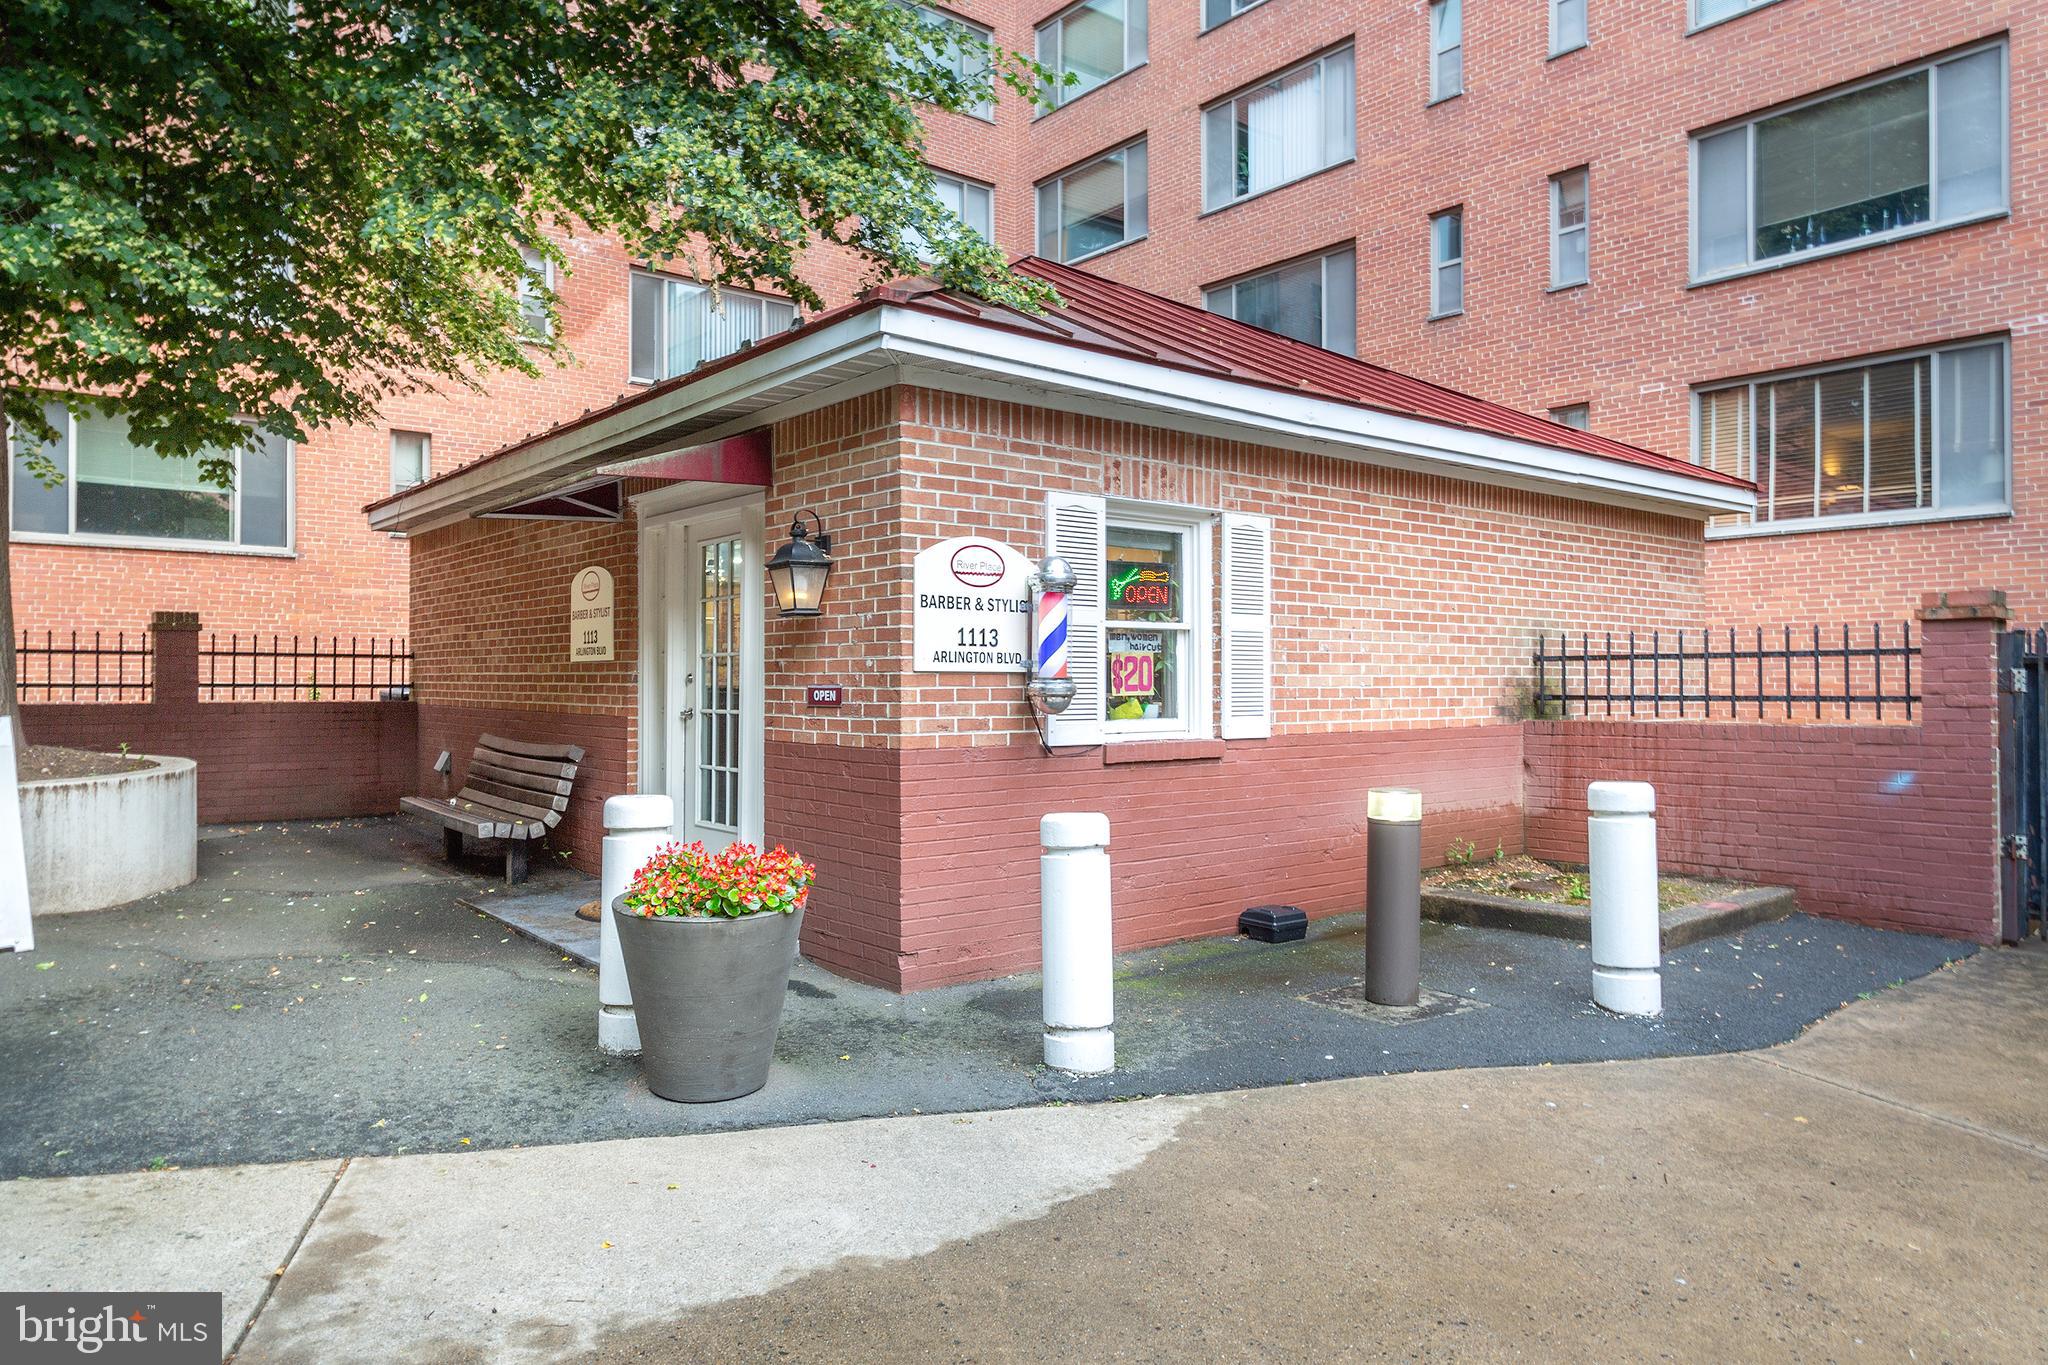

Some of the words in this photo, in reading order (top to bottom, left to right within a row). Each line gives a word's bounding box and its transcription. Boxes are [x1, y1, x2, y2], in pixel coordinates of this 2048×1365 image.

[956, 559, 978, 570] River
[979, 561, 1002, 572] Place
[1124, 585, 1168, 605] OPEN
[920, 594, 971, 611] BARBER
[974, 597, 984, 611] &
[572, 608, 588, 620] BARBER
[593, 607, 611, 619] STYLIST
[583, 630, 598, 644] 1113
[957, 627, 999, 647] 1113
[575, 647, 596, 656] ARLINGTON
[596, 646, 607, 655] BLVD
[933, 650, 995, 664] ARLINGTON
[996, 652, 1022, 665] BLVD
[1112, 653, 1153, 693] $20
[813, 690, 836, 702] OPEN
